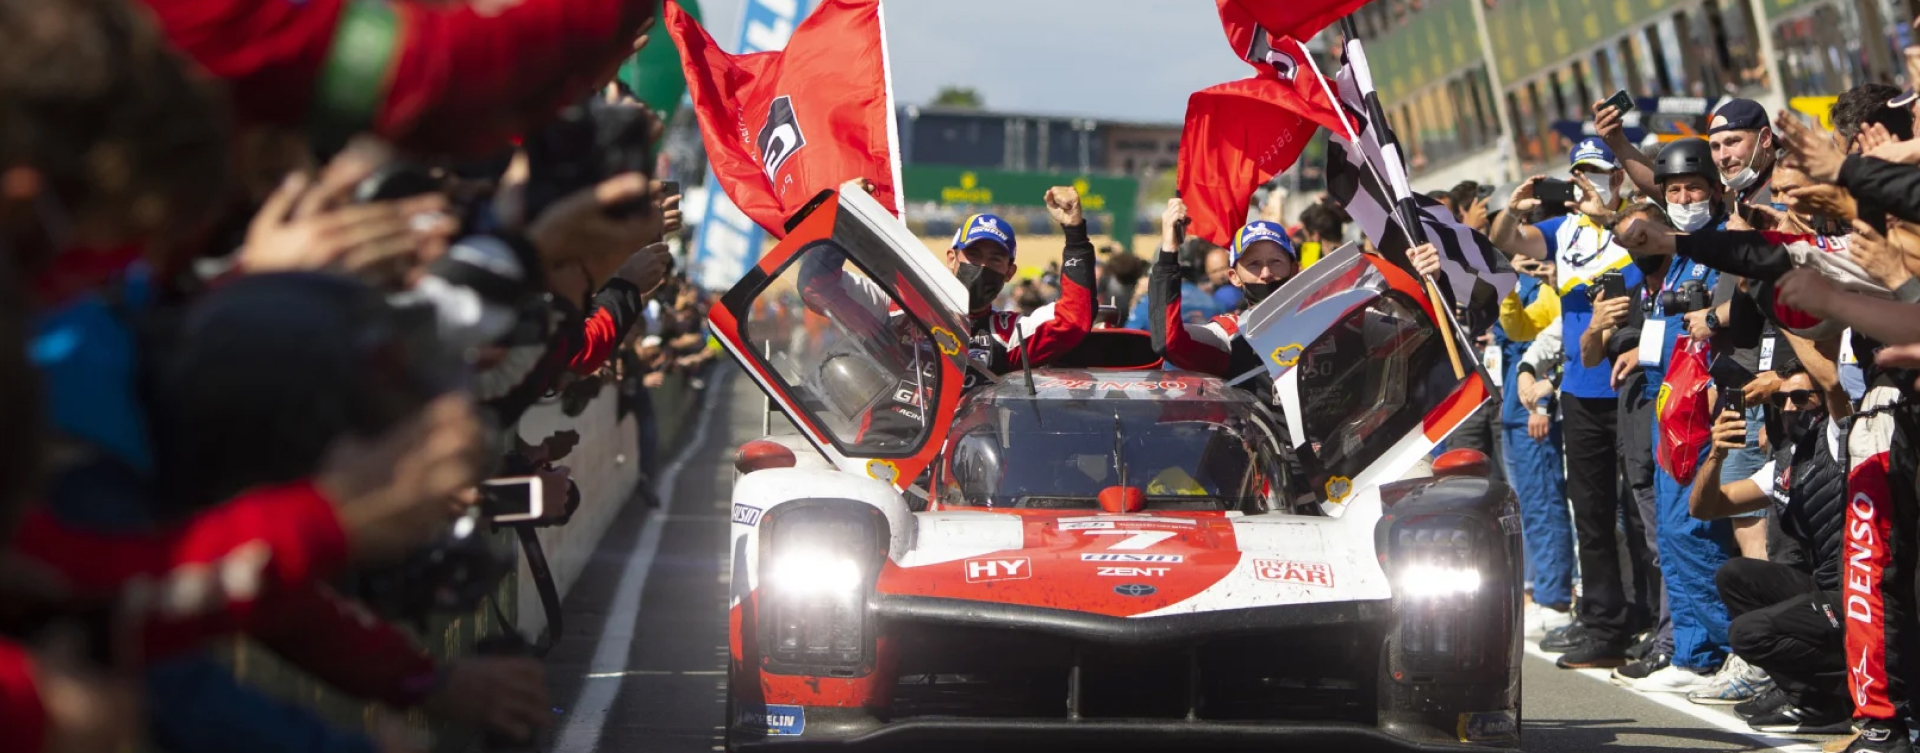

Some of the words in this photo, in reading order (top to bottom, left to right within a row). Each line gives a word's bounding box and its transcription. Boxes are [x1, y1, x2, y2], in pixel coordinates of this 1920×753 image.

[1036, 378, 1188, 391] DENSO
[891, 405, 925, 421] RACIN
[1083, 530, 1178, 550] 7
[1258, 560, 1326, 572] HYPER
[1847, 491, 1874, 624] DENSO
[969, 559, 1026, 578] HY
[1097, 566, 1171, 577] ZENT
[1261, 567, 1328, 585] CAR
